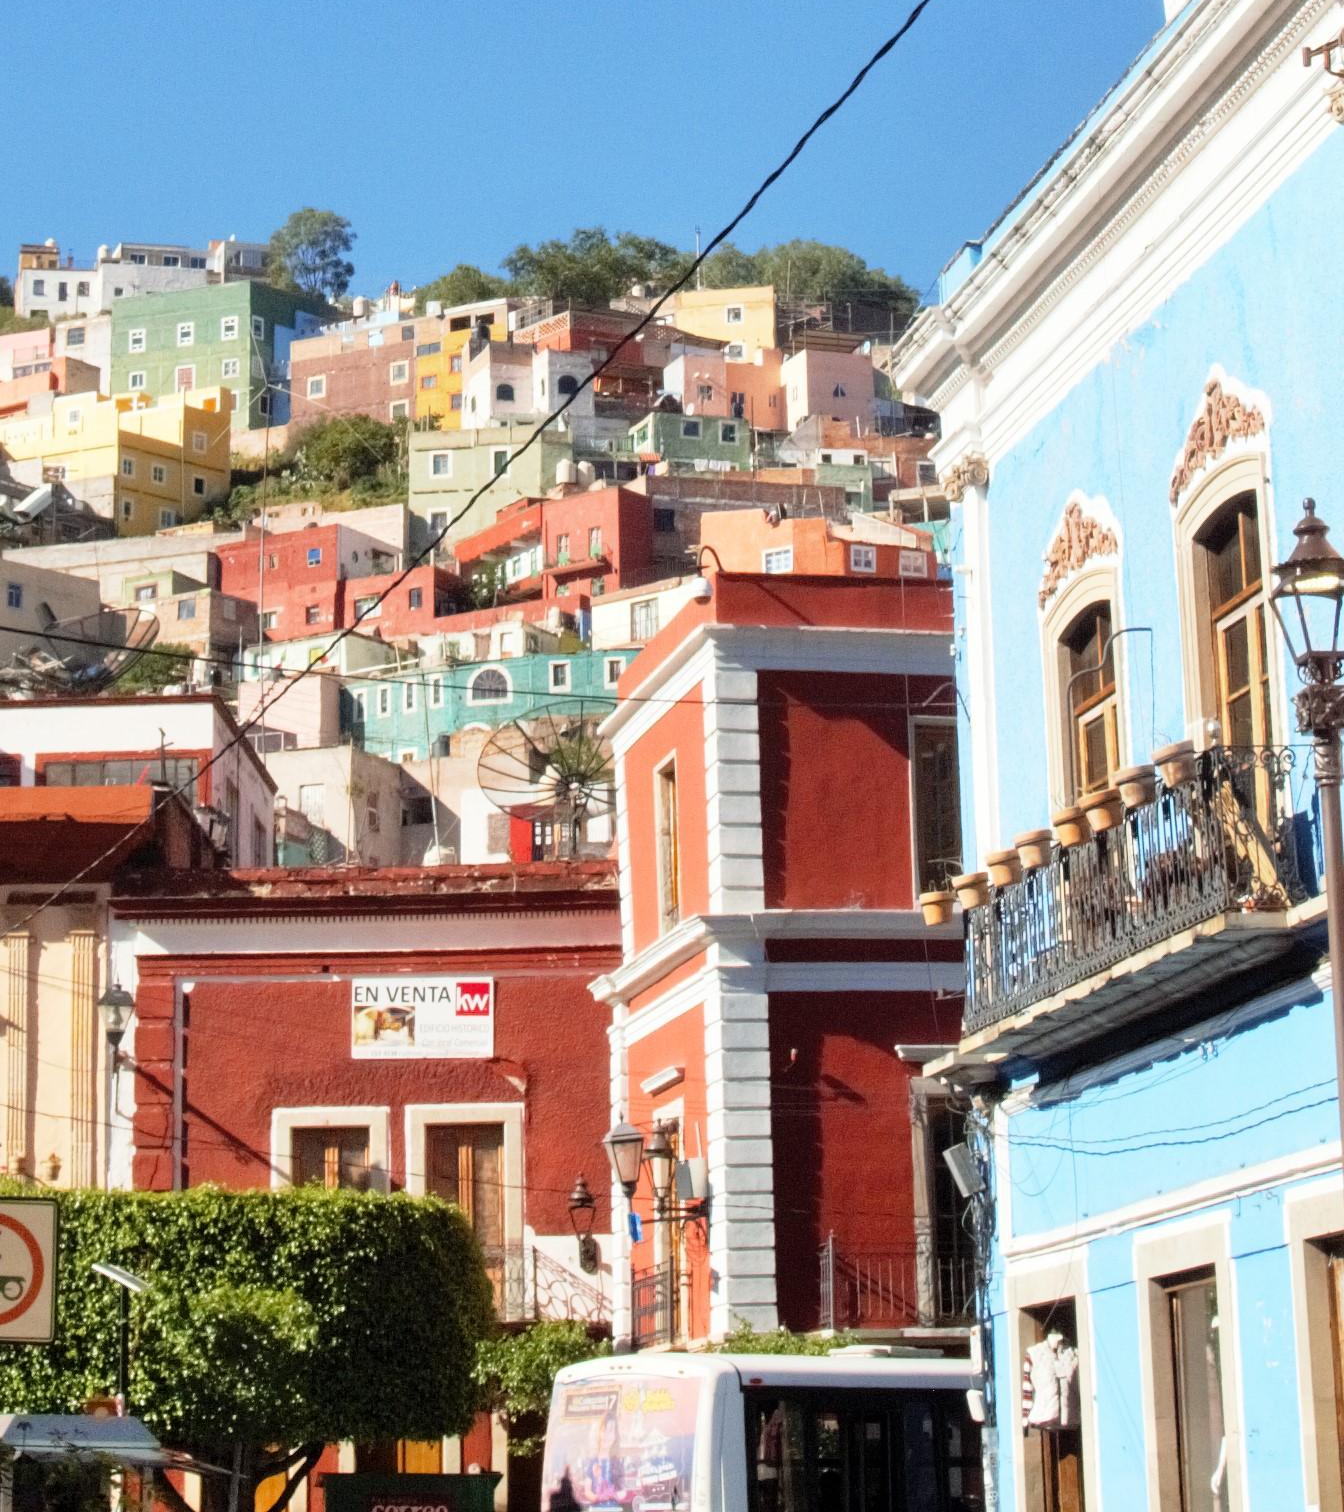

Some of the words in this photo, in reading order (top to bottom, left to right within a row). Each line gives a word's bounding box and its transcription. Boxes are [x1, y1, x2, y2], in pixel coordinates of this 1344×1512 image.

[354, 986, 379, 1003] EN
[386, 986, 452, 1003] VENTA
[456, 986, 489, 1012] kw
